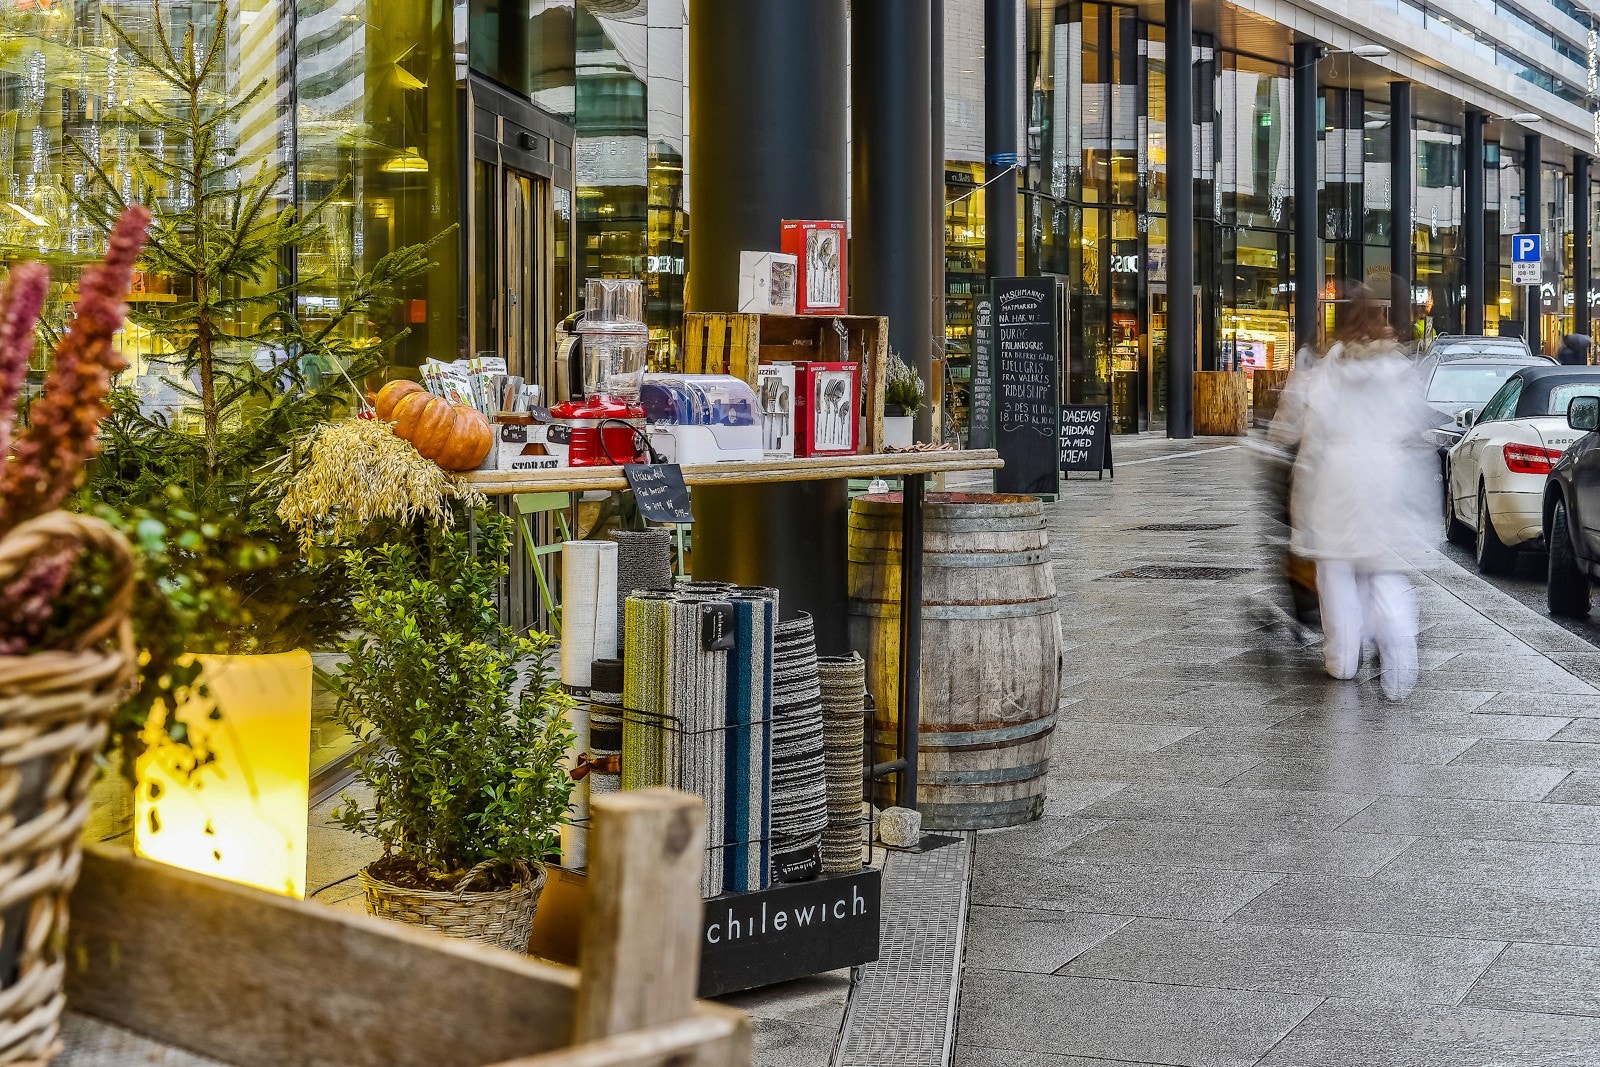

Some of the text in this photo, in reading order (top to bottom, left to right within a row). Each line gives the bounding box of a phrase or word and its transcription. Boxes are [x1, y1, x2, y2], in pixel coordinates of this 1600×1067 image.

[1520, 238, 1535, 260] P
[1062, 409, 1101, 423] DAGENS
[1059, 437, 1092, 448] TA MED
[1060, 449, 1088, 463] HJEM
[782, 860, 816, 875] chilewich
